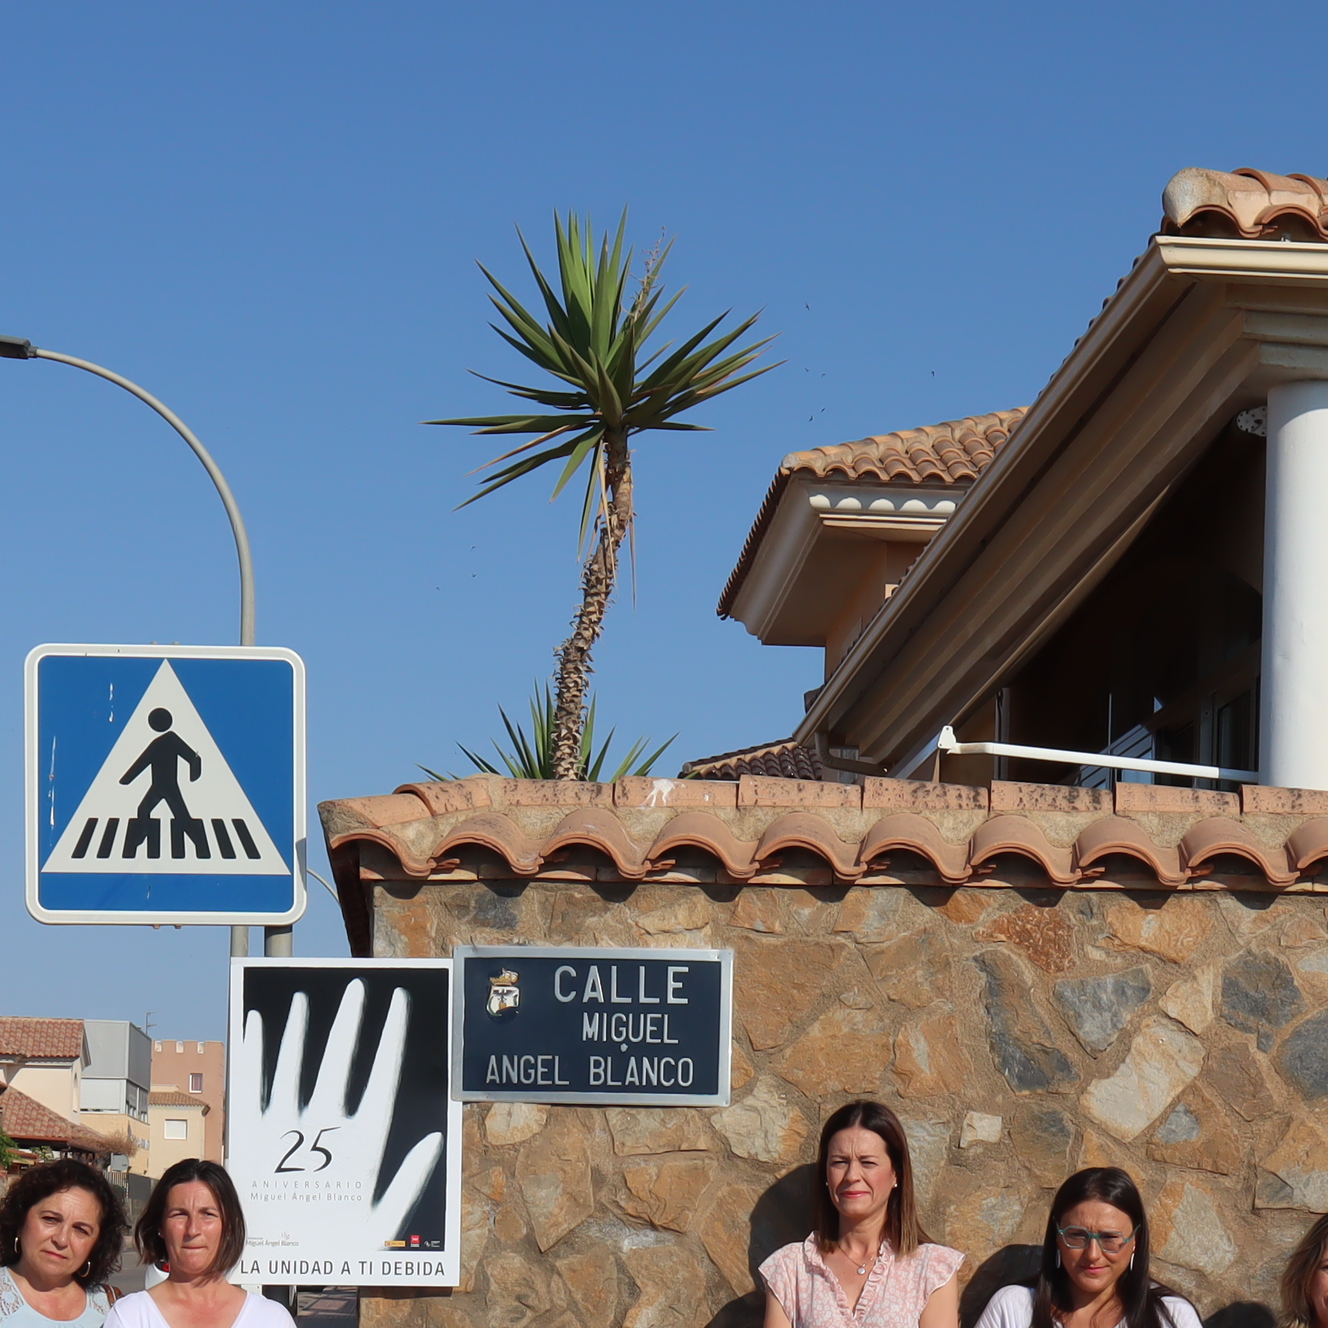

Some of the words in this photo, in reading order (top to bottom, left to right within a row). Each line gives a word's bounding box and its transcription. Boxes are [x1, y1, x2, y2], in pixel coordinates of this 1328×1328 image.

[553, 965, 689, 1005] CALLE
[582, 1011, 679, 1044] MIGUEL
[485, 1054, 570, 1086] ANGEL
[589, 1055, 695, 1087] BLANCO
[274, 1126, 342, 1174] 25
[250, 1192, 287, 1202] Miguel
[292, 1191, 322, 1202] Ángel
[327, 1192, 362, 1201] Blanco
[251, 1180, 362, 1189] ANIVERSARIO
[240, 1260, 261, 1275] LA
[269, 1260, 333, 1275] UNIDAD
[341, 1260, 351, 1275] A
[358, 1260, 373, 1276] TI
[381, 1261, 446, 1277] DEBIDA
